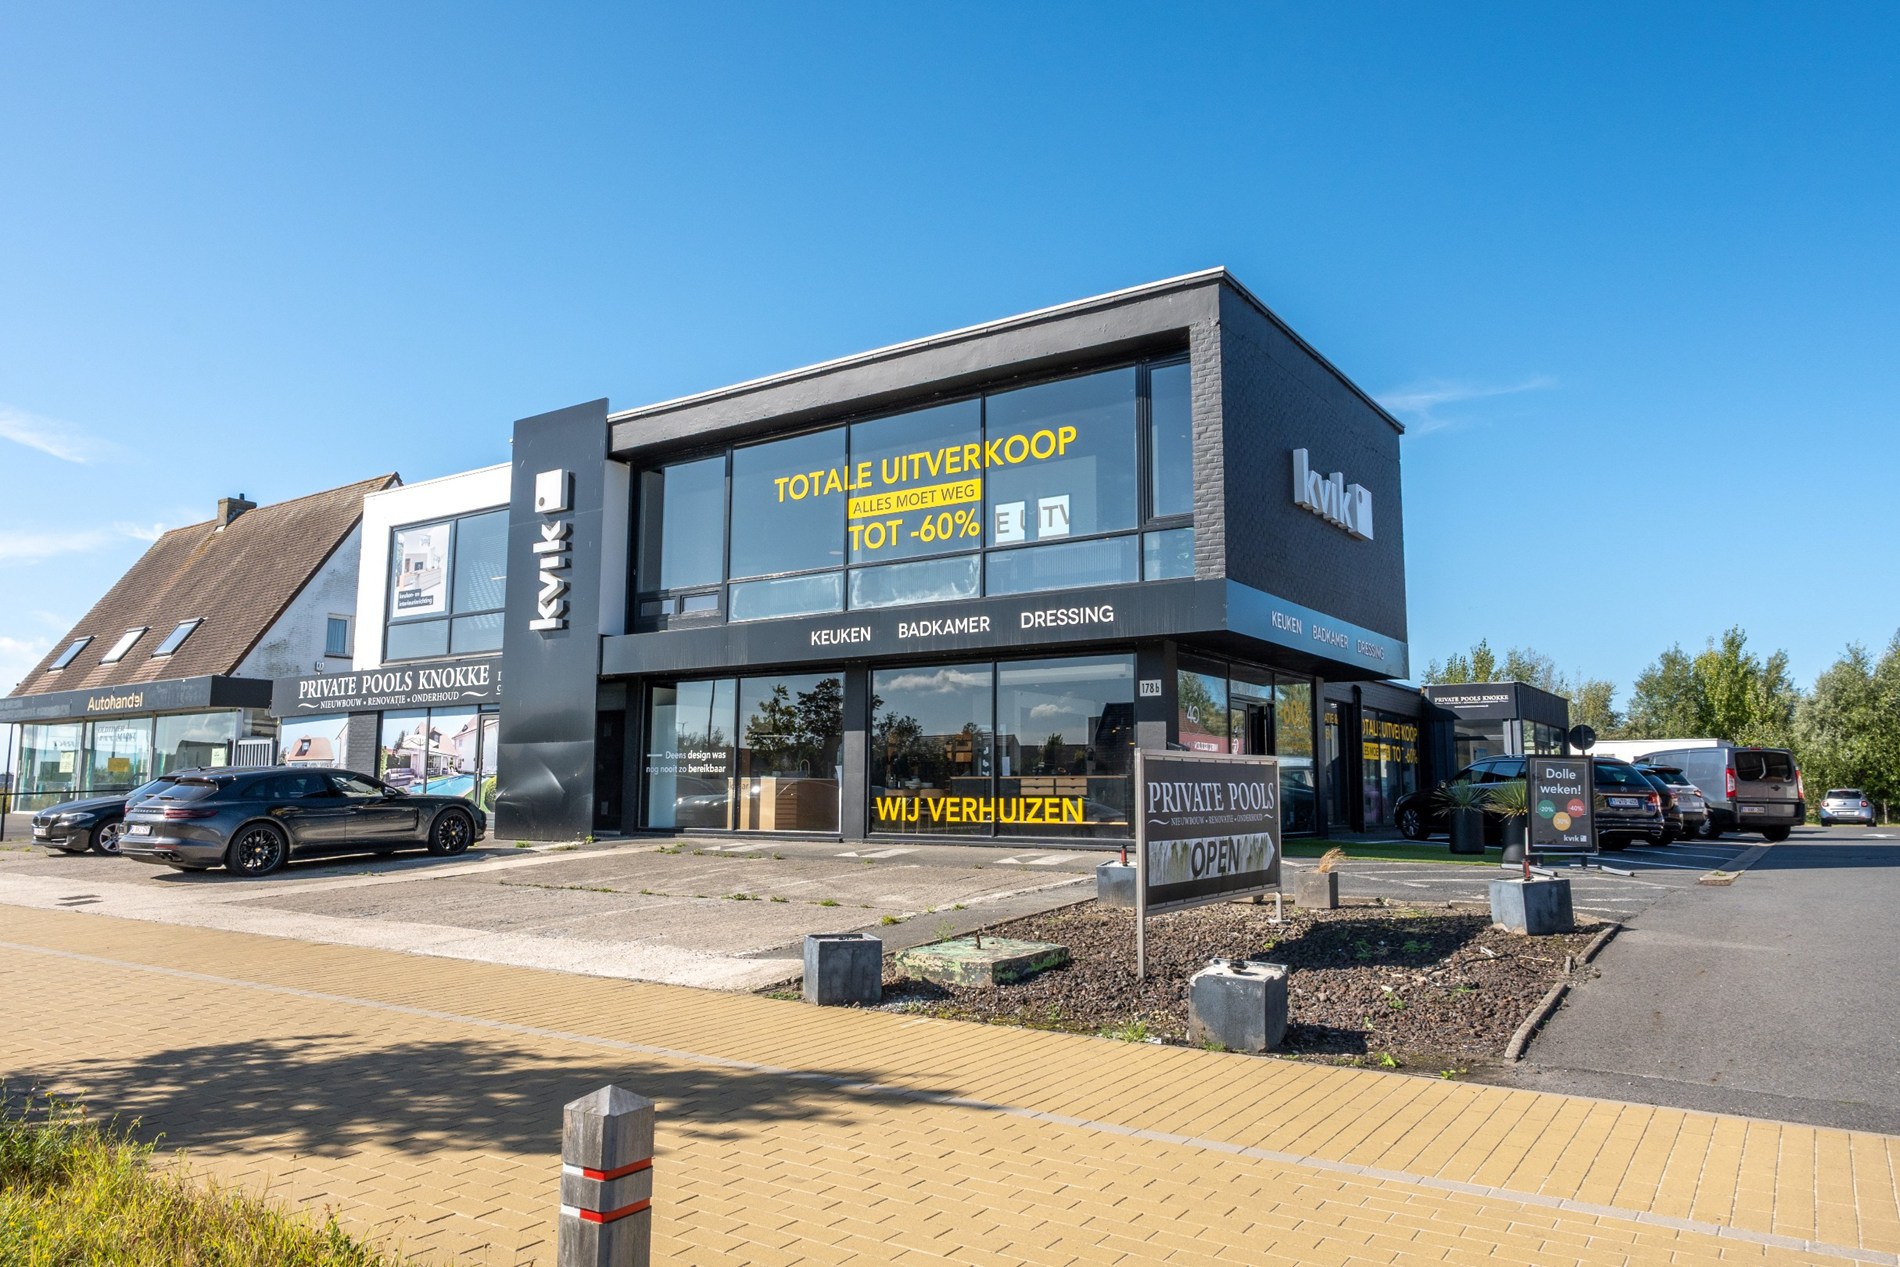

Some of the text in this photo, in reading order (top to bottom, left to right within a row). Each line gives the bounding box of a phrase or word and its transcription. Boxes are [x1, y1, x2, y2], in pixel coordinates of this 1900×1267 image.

[775, 426, 1077, 503] TOTALE UITVERKOOP
[853, 484, 975, 514] ALLES MOET WEG
[1293, 448, 1353, 532] kvik
[848, 508, 980, 551] TOT -60%
[529, 520, 567, 630] kvik
[811, 605, 1114, 646] KEUKEN BADKAMER DRESSING
[1271, 610, 1384, 660] KEUKEN BADKAMER DRESSING
[299, 676, 357, 699] PRIVATE
[361, 671, 413, 694] POOLS
[418, 664, 490, 690] KNOKKE
[87, 691, 143, 711] Autohandel
[320, 691, 460, 709] NIEUWBOUW RENOVATIE ONDERHOUD
[646, 767, 660, 775] nog
[660, 764, 677, 773] nooit
[688, 764, 726, 773] bereikbaar
[665, 751, 687, 760] Deens
[687, 750, 711, 761] design
[1540, 783, 1581, 795] weken!
[1546, 768, 1576, 780] Dolle
[876, 797, 1083, 824] WIJ VERHUIZEN
[1148, 782, 1274, 813] PRIVATE POOLS
[1563, 834, 1580, 842] kvik
[1191, 836, 1241, 877] OPEN
